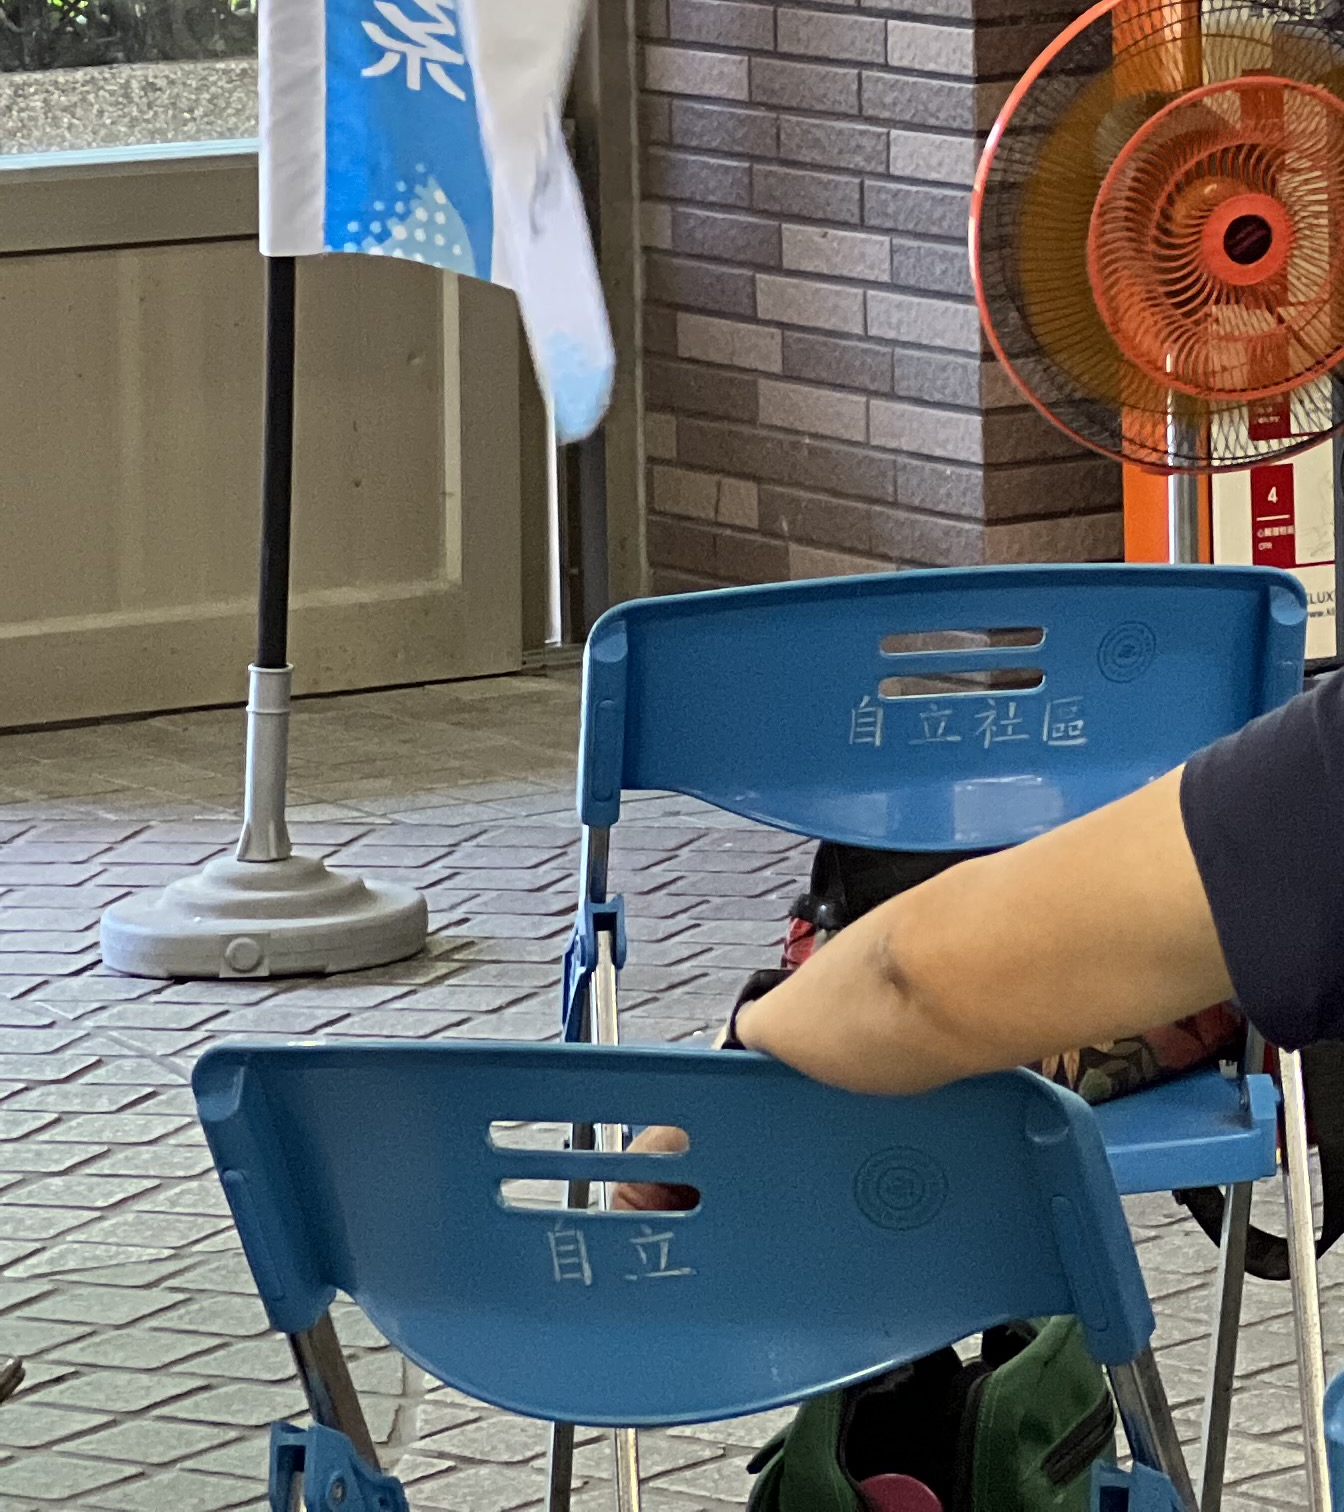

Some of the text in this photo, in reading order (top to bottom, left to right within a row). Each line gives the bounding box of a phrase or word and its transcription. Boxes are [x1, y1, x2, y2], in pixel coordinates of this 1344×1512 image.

[1267, 486, 1278, 504] 4
[848, 694, 1091, 747] 自立社區
[545, 1223, 698, 1286] 自立
